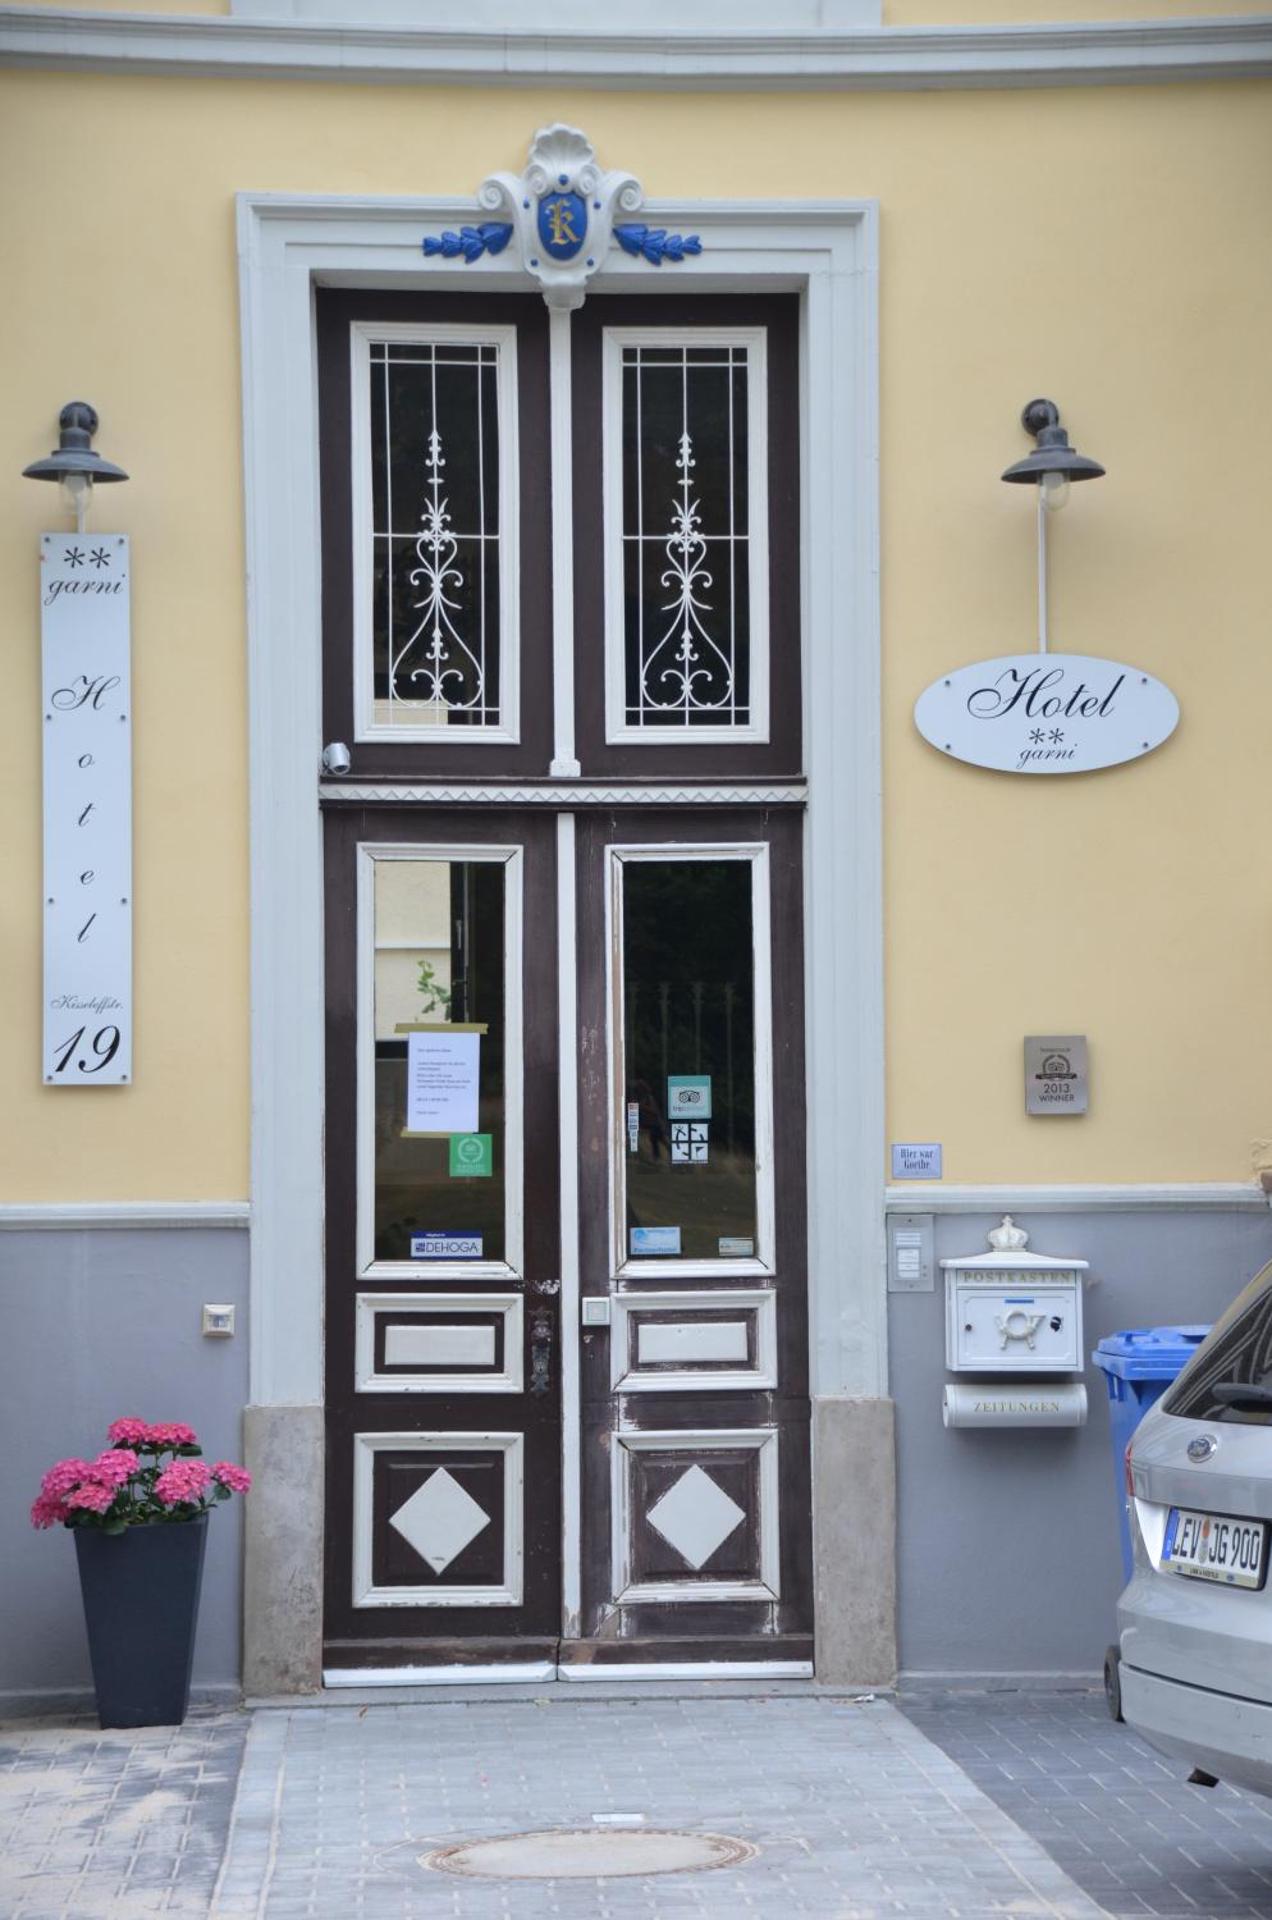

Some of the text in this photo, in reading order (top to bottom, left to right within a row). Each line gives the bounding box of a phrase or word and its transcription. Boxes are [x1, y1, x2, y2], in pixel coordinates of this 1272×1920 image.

[44, 574, 126, 606] garni
[967, 668, 1126, 719] Hotel
[1016, 743, 1078, 770] garni
[51, 674, 121, 945] Hotel
[53, 1024, 121, 1073] 19
[1039, 1095, 1075, 1103] WINNER
[1043, 1083, 1070, 1094] 2013
[426, 1242, 478, 1253] DEHOGA
[964, 1271, 1072, 1284] POSTKASTEN
[974, 1401, 1060, 1413] ZEITUNGEN
[1171, 1516, 1260, 1571] LEV JG 900
